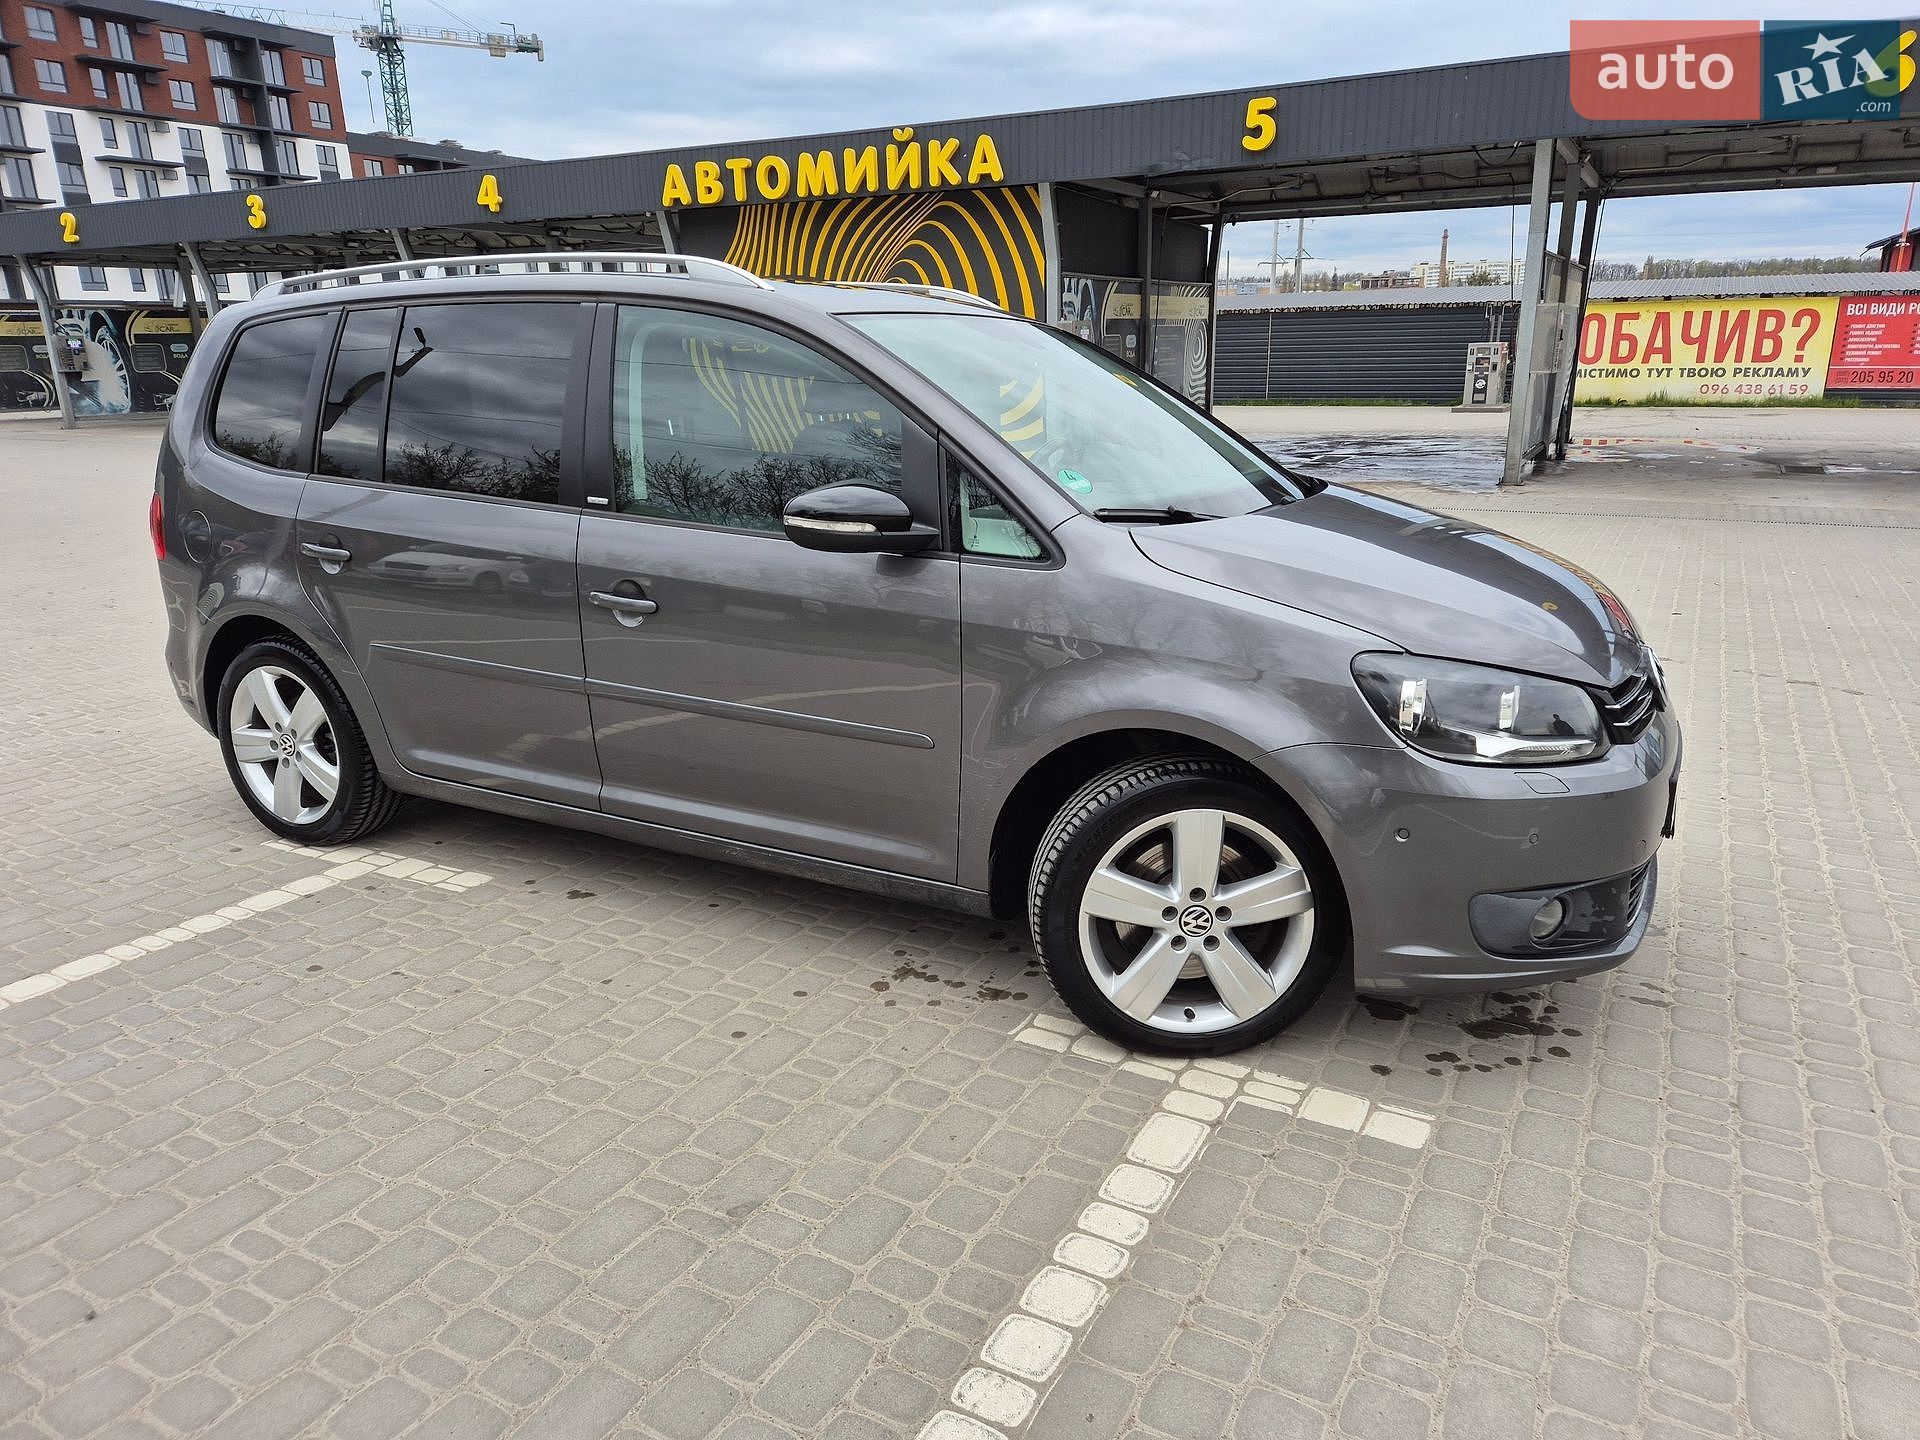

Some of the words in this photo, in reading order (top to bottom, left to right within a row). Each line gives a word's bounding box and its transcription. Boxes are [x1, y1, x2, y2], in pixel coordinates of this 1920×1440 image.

[1864, 30, 1917, 97] 6
[1242, 97, 1277, 151] 5
[662, 127, 1004, 207] АВТОМИЙКА
[477, 174, 503, 213] 4
[60, 212, 80, 243] 2
[246, 195, 267, 229] 3
[1847, 303, 1868, 316] ВСІ
[1870, 302, 1906, 317] ВИДИ
[1647, 368, 1673, 378] ТУТ
[1679, 367, 1727, 378] ТВОЮ
[1732, 367, 1812, 378] РЕКЛАМУ
[1851, 370, 1875, 384] 205
[1878, 370, 1895, 384] 95
[1897, 370, 1914, 384] 20
[1699, 384, 1730, 395] 096
[1734, 384, 1763, 395] 438
[1788, 384, 1809, 395] 59
